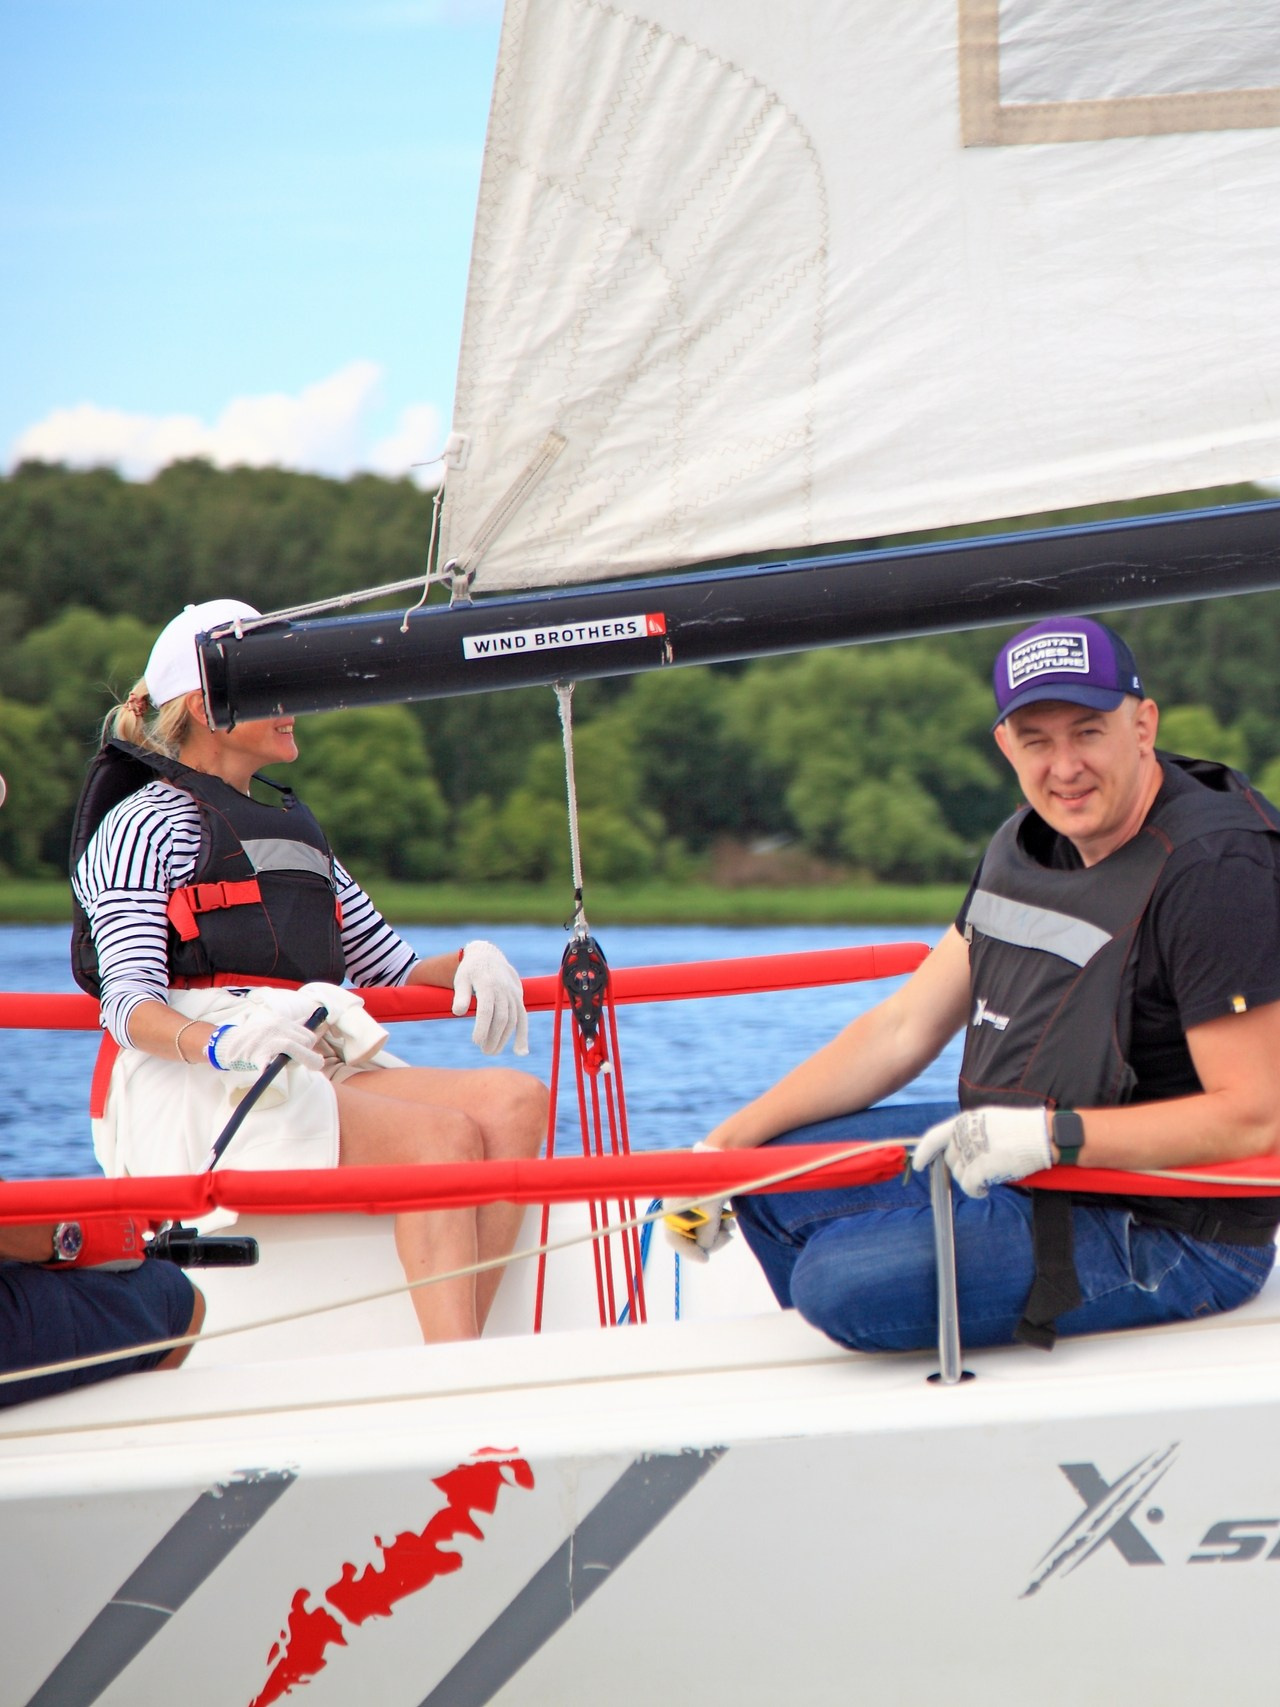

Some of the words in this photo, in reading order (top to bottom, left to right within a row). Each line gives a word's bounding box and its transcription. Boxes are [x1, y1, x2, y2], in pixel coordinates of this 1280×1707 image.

[474, 636, 526, 653] WIND
[535, 621, 637, 646] BROTHERS
[1012, 647, 1069, 671] GAMES
[1025, 658, 1085, 674] FUTURE
